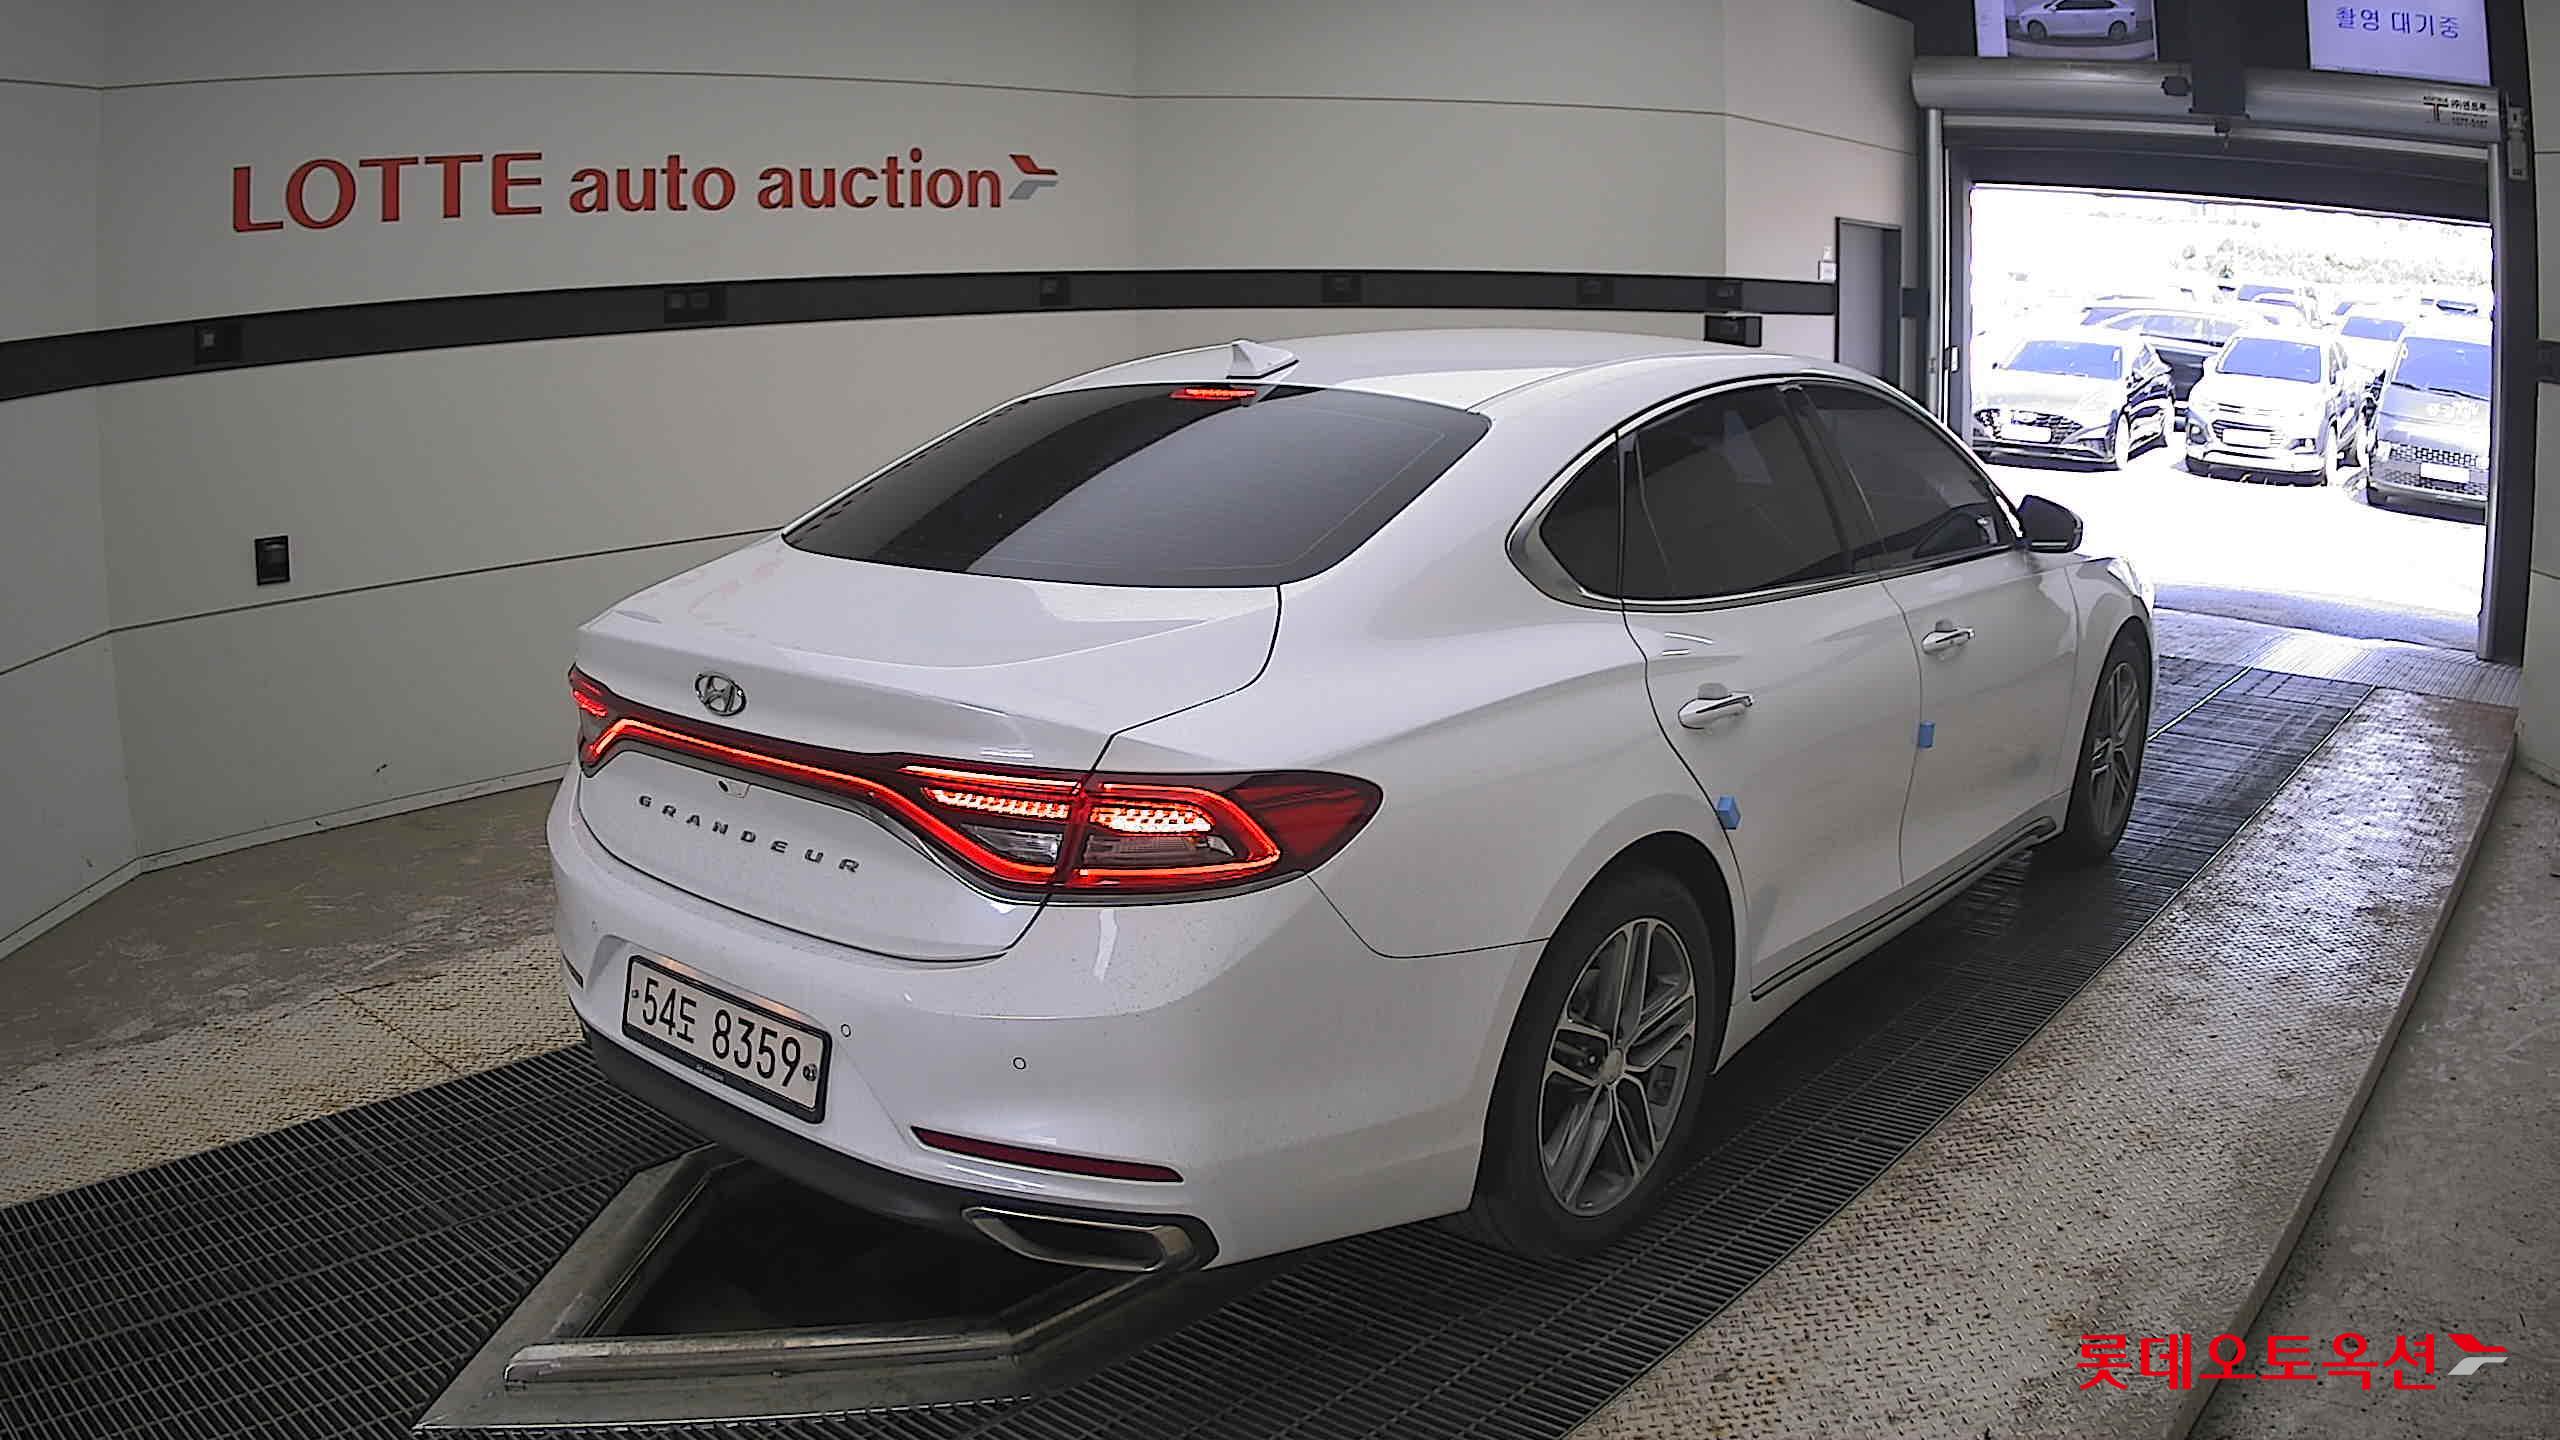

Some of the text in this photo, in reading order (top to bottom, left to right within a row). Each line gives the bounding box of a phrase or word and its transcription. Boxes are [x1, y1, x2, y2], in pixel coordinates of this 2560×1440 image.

[2336, 7, 2459, 39] 촬영 대기중
[232, 147, 1003, 233] LOTTE auto auction
[638, 794, 863, 874] GRANDEUR
[641, 977, 802, 1089] 54도 8359
